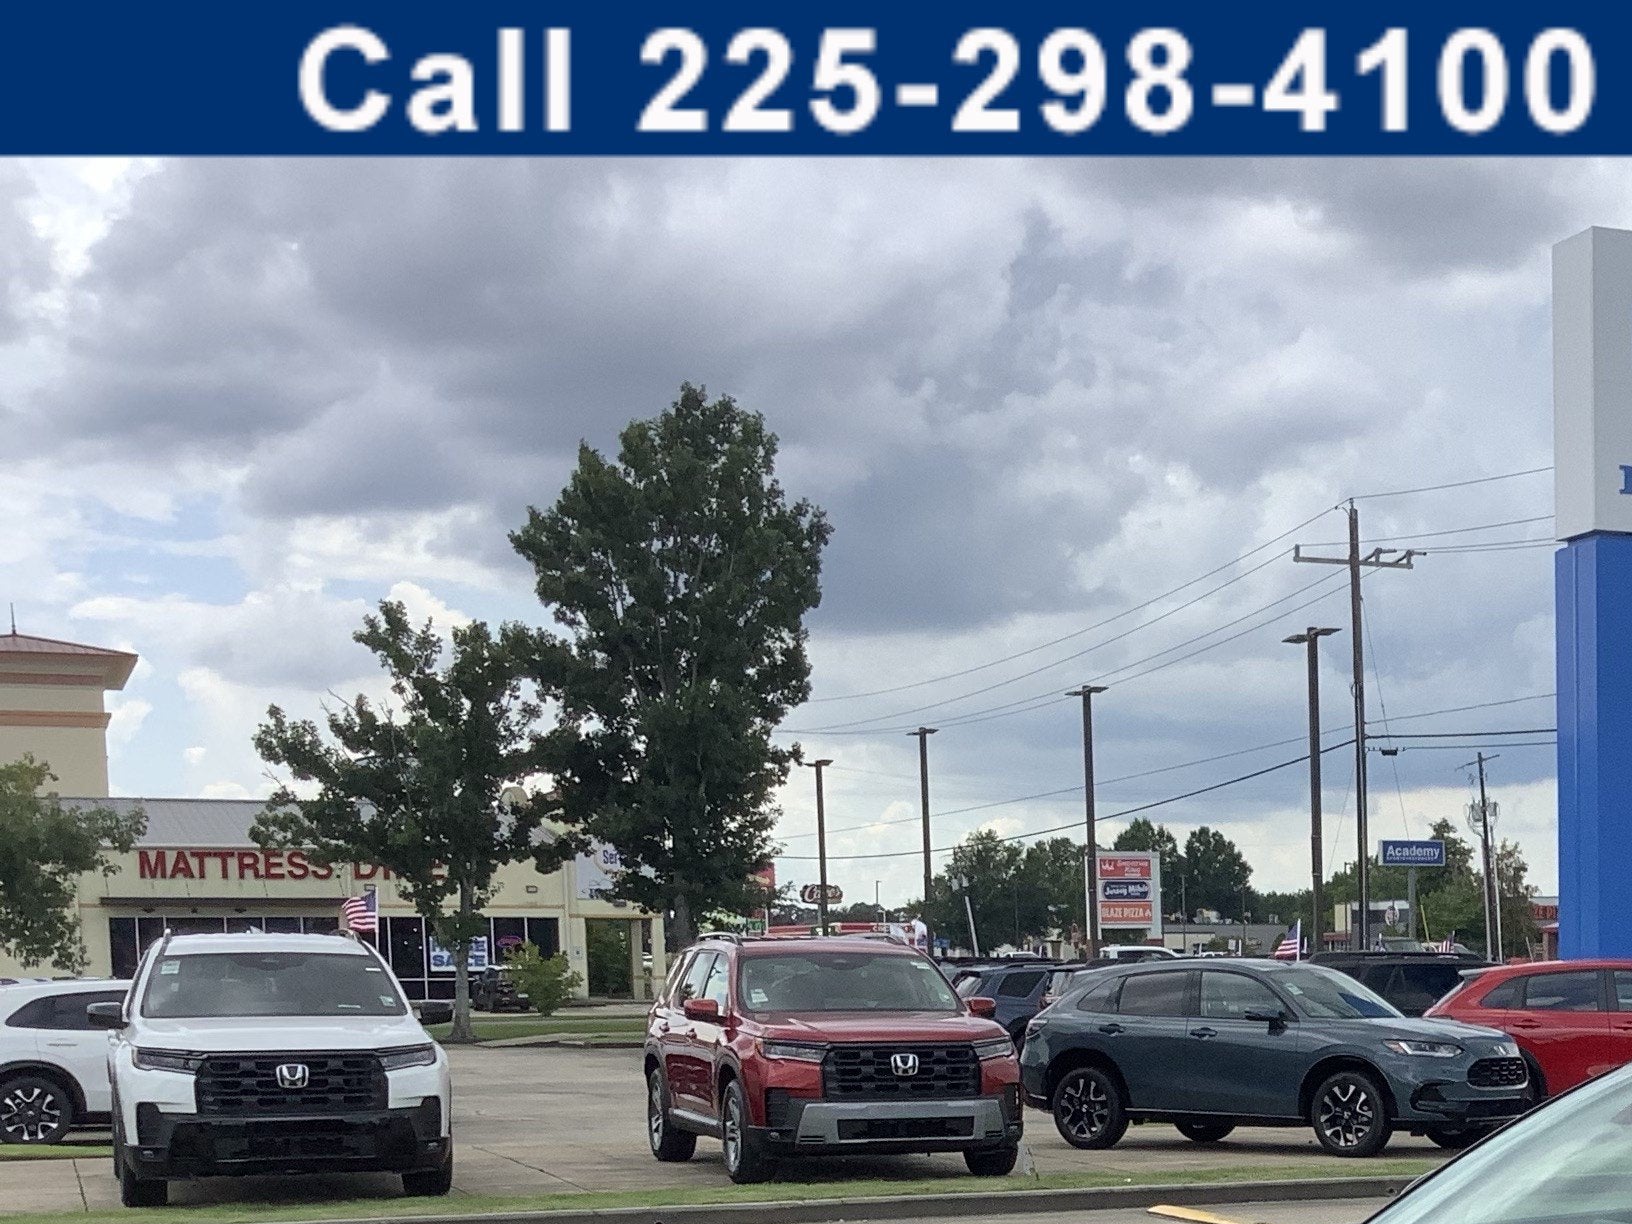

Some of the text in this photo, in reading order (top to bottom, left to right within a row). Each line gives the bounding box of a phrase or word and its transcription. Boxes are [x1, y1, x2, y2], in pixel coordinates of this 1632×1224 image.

[1386, 845, 1440, 860] Academy
[138, 850, 333, 880] MATTRESS
[1123, 907, 1144, 918] PIZZA
